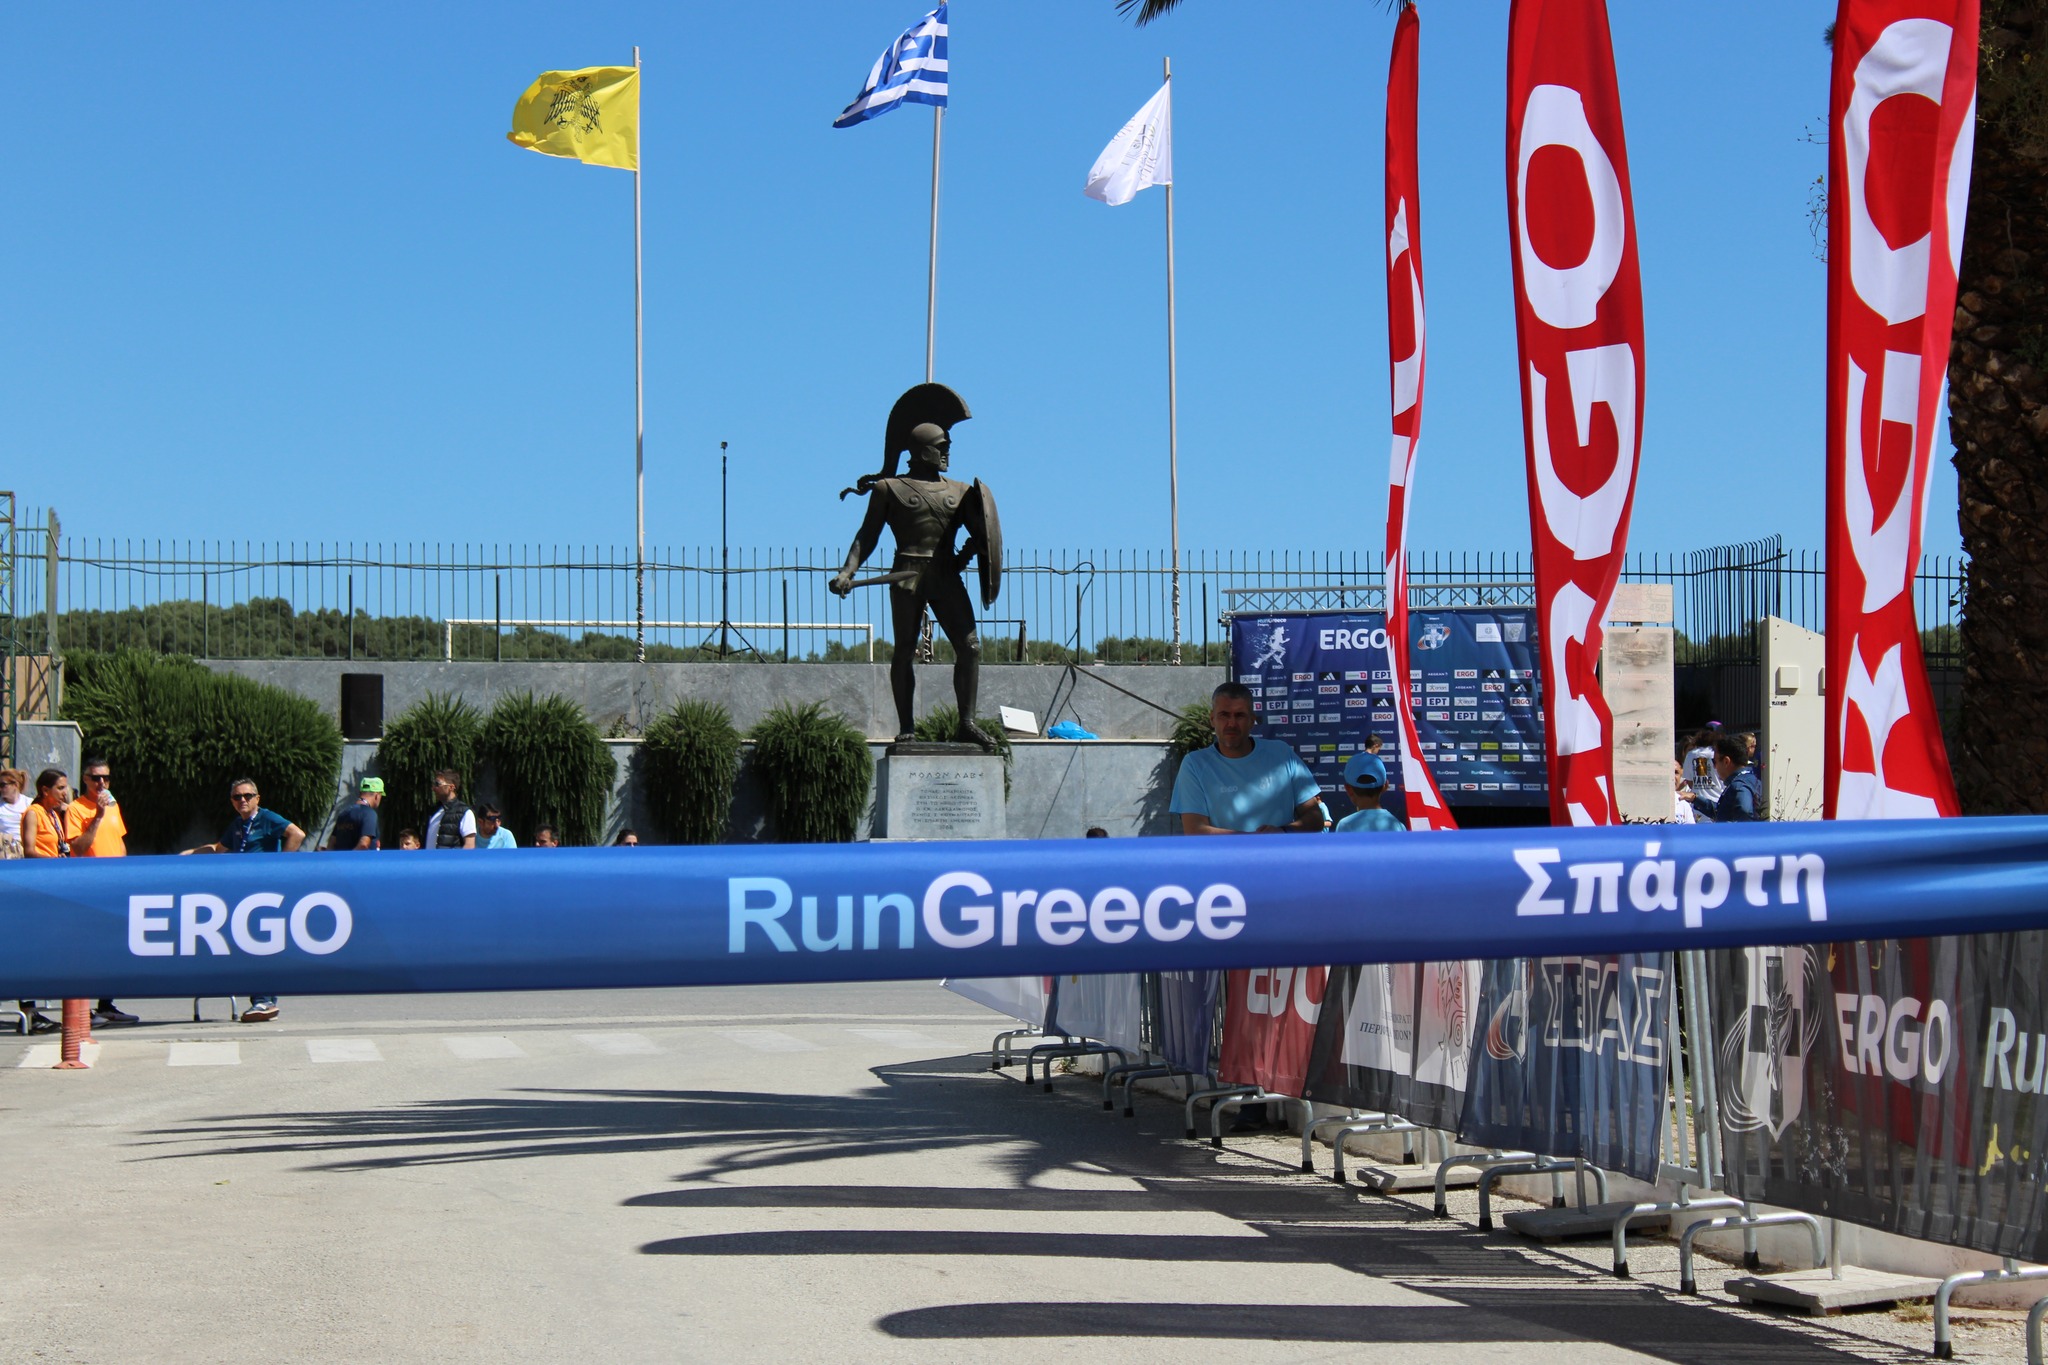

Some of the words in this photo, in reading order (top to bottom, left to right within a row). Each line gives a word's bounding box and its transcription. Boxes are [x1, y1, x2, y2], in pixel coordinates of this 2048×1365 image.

[1320, 628, 1387, 650] ERGO
[128, 892, 352, 956] ERGO
[728, 871, 1247, 954] RunGreece
[1514, 842, 1828, 928] Σπάρτη
[1835, 993, 1950, 1084] ERGO
[1983, 1007, 2048, 1095] Ru
